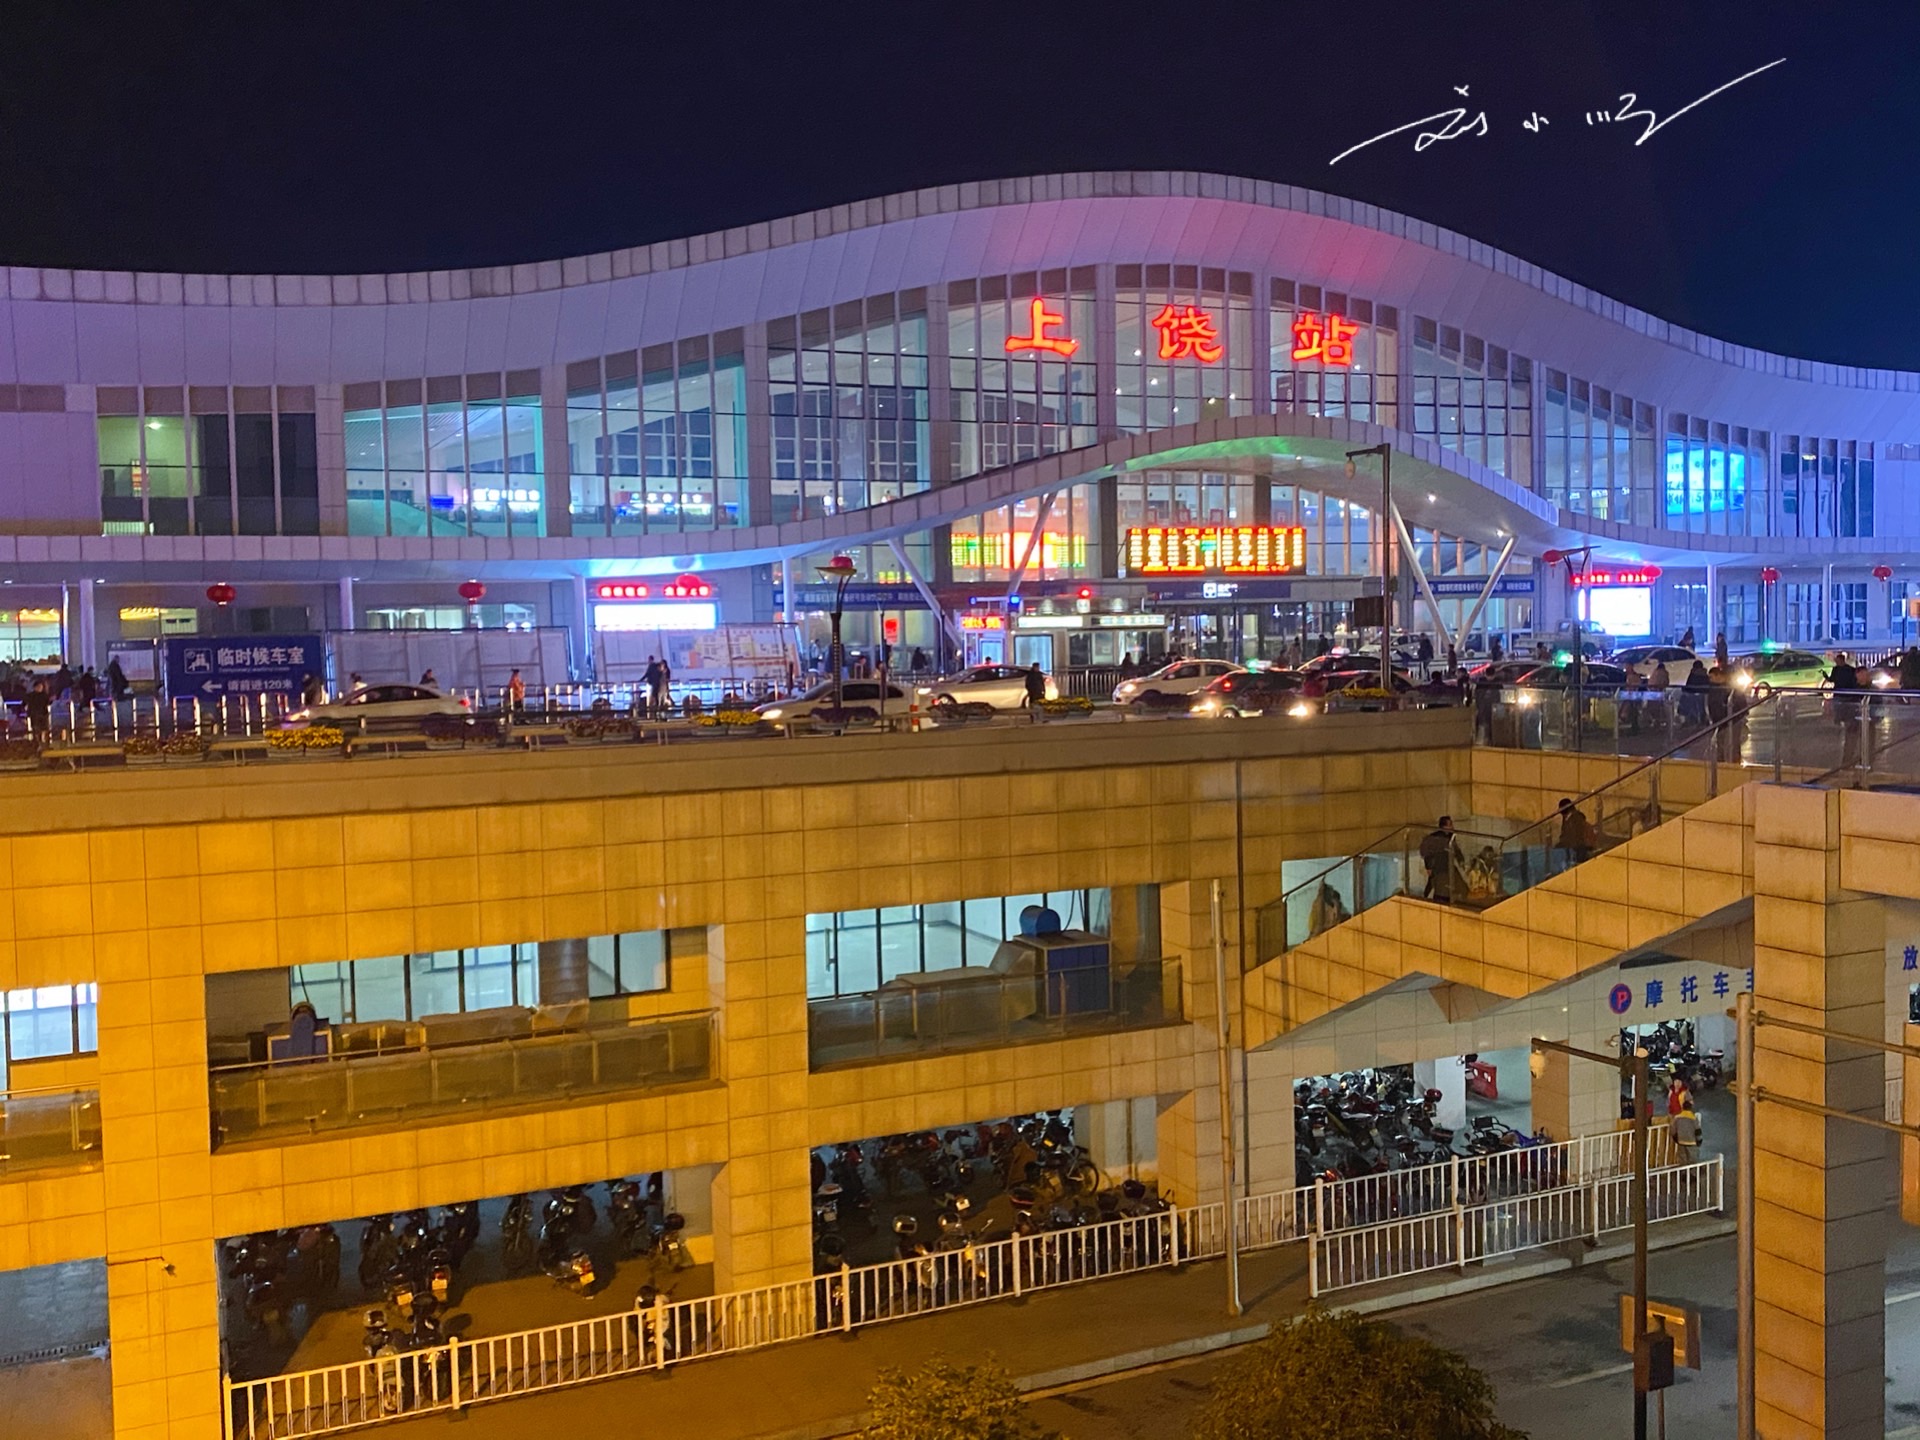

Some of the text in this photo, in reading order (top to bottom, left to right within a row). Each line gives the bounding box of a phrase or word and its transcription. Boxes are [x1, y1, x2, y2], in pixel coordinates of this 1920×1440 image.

[1005, 296, 1360, 367] 上饶站
[217, 646, 305, 666] 临时候车室
[1903, 945, 1918, 971] 放
